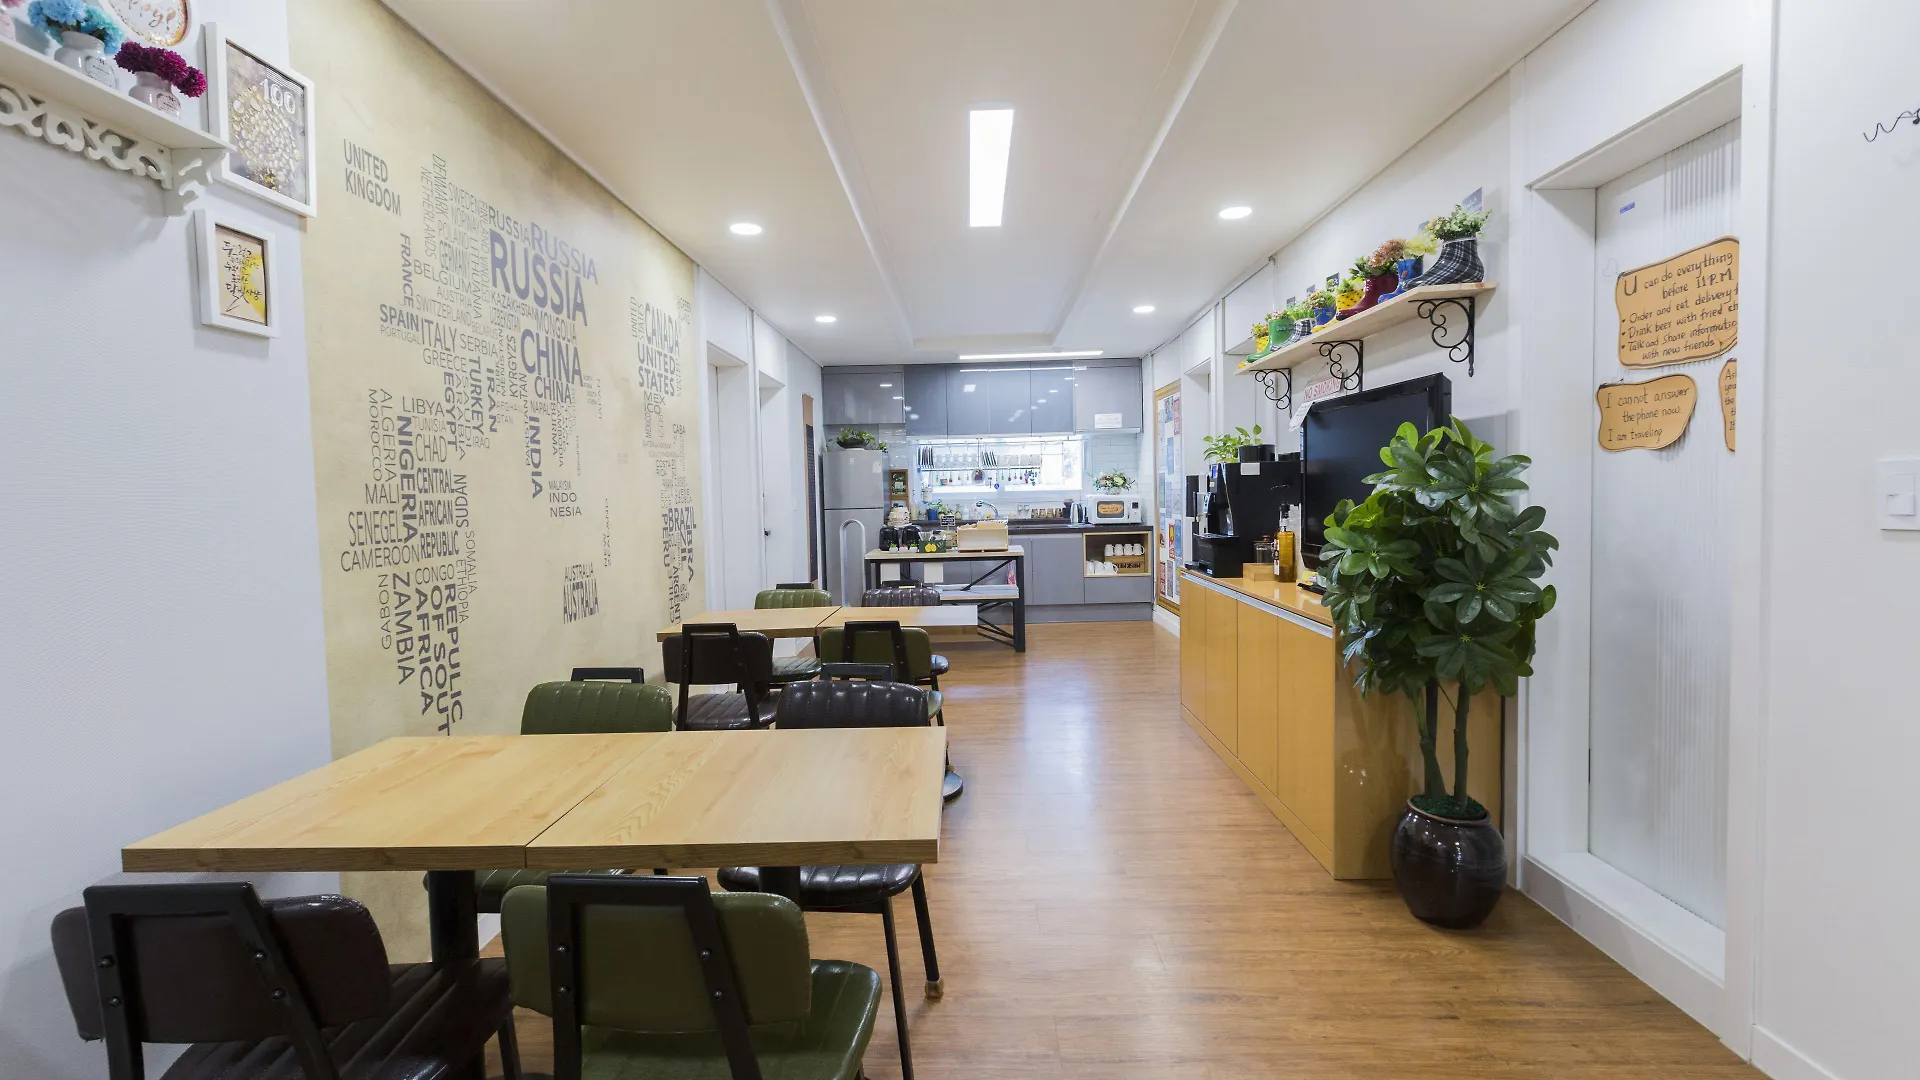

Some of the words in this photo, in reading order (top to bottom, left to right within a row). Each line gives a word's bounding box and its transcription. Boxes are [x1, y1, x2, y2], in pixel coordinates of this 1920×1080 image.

[343, 138, 389, 183] UNITED
[345, 167, 401, 217] KINGDOM
[432, 153, 449, 220] DENMARK
[420, 166, 437, 262] NETHERLANDS
[489, 205, 531, 248] RUSSIA
[400, 232, 414, 308] FRANCE
[531, 221, 599, 286] RUSSIA
[413, 259, 471, 294] BELGIUM
[489, 228, 588, 327] RUSSIA
[1624, 275, 1638, 296] U
[1644, 277, 1659, 289] can
[1661, 266, 1673, 282] do
[1677, 252, 1733, 277] everything
[1662, 284, 1689, 299] before
[380, 303, 420, 333] SPAIN
[416, 294, 472, 327] SWITZERLAND
[1628, 323, 1652, 339] Drink
[1655, 317, 1673, 332] beer
[1676, 311, 1697, 326] with
[1700, 304, 1723, 321] fried
[1629, 311, 1653, 324] Order
[1656, 303, 1671, 316] and
[1676, 299, 1690, 311] eat
[1695, 288, 1733, 305] delivery
[421, 317, 457, 352] ITALY
[460, 333, 499, 358] SERBIA
[644, 302, 680, 356] CANADA
[422, 348, 468, 373] GREECE
[506, 333, 519, 398] KYRGYZS
[520, 328, 584, 388] CHINA
[637, 341, 676, 375] UNITED
[1642, 348, 1659, 361] with
[1662, 346, 1681, 356] new
[1684, 334, 1715, 352] friends
[469, 356, 484, 435] TURKEY
[519, 372, 529, 400] TAN
[534, 375, 573, 405] CHINA
[638, 365, 676, 397] STATES
[643, 390, 666, 405] MEX
[1303, 387, 1313, 401] NO
[1314, 376, 1341, 398] SMOKING
[1606, 393, 1611, 408] I
[1618, 387, 1649, 407] cannot
[1653, 388, 1690, 398] answer
[402, 396, 446, 417] LIBYA
[443, 371, 458, 452] EGYPT
[486, 367, 498, 433] IRAN
[1634, 409, 1659, 425] phone
[1661, 406, 1681, 416] now
[368, 388, 383, 482] MOROCCO
[380, 388, 397, 483] ALGERIA
[415, 433, 448, 463] CHAD
[1607, 428, 1613, 442] I
[1616, 432, 1627, 441] am
[1630, 424, 1663, 443] traveling
[528, 416, 543, 499] INDIA
[364, 483, 401, 505] MALI
[396, 415, 418, 544] NIGERIA
[416, 467, 455, 494] CENTRAL
[549, 492, 578, 503] INDO
[418, 499, 455, 526] AFRICAN
[453, 474, 469, 528] SUDAN
[549, 506, 583, 518] NESIA
[668, 506, 697, 532] BRAZIL
[347, 510, 403, 547] SENEGEL
[420, 530, 460, 559] REPUBLIC
[662, 514, 677, 567] PERU
[340, 544, 421, 572] CAMEROON
[415, 563, 455, 585] CONGO
[465, 530, 478, 594] SOMALIA
[564, 561, 594, 582] AUSTRALIA
[430, 584, 445, 632] OF
[456, 559, 469, 624] ETHIOPIA
[563, 577, 600, 625] AUSTRALIA
[378, 573, 393, 650] GABON
[392, 571, 416, 685] ZAMBIA
[415, 587, 434, 716] AFRICA
[444, 583, 463, 723] REPULIC
